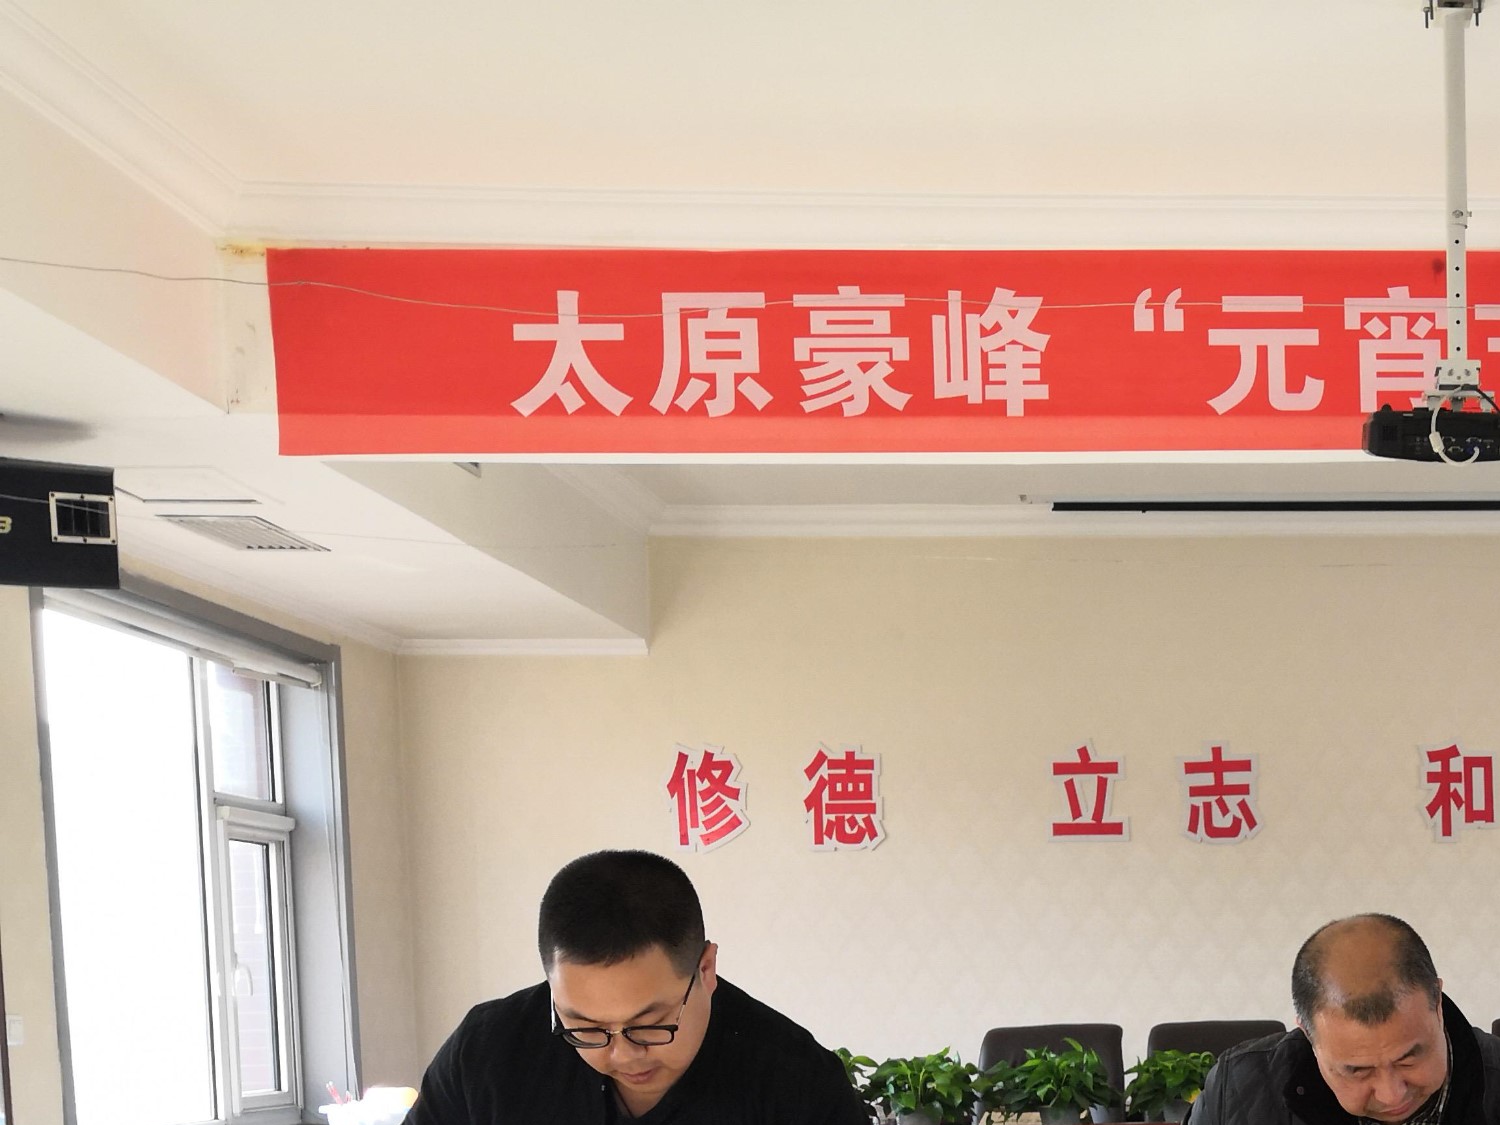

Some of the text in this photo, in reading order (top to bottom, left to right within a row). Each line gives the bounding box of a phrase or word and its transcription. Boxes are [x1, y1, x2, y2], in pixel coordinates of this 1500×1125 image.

[512, 287, 1051, 418] 太原豪峰
[666, 749, 880, 846] 修德
[1052, 745, 1257, 839] 立志
